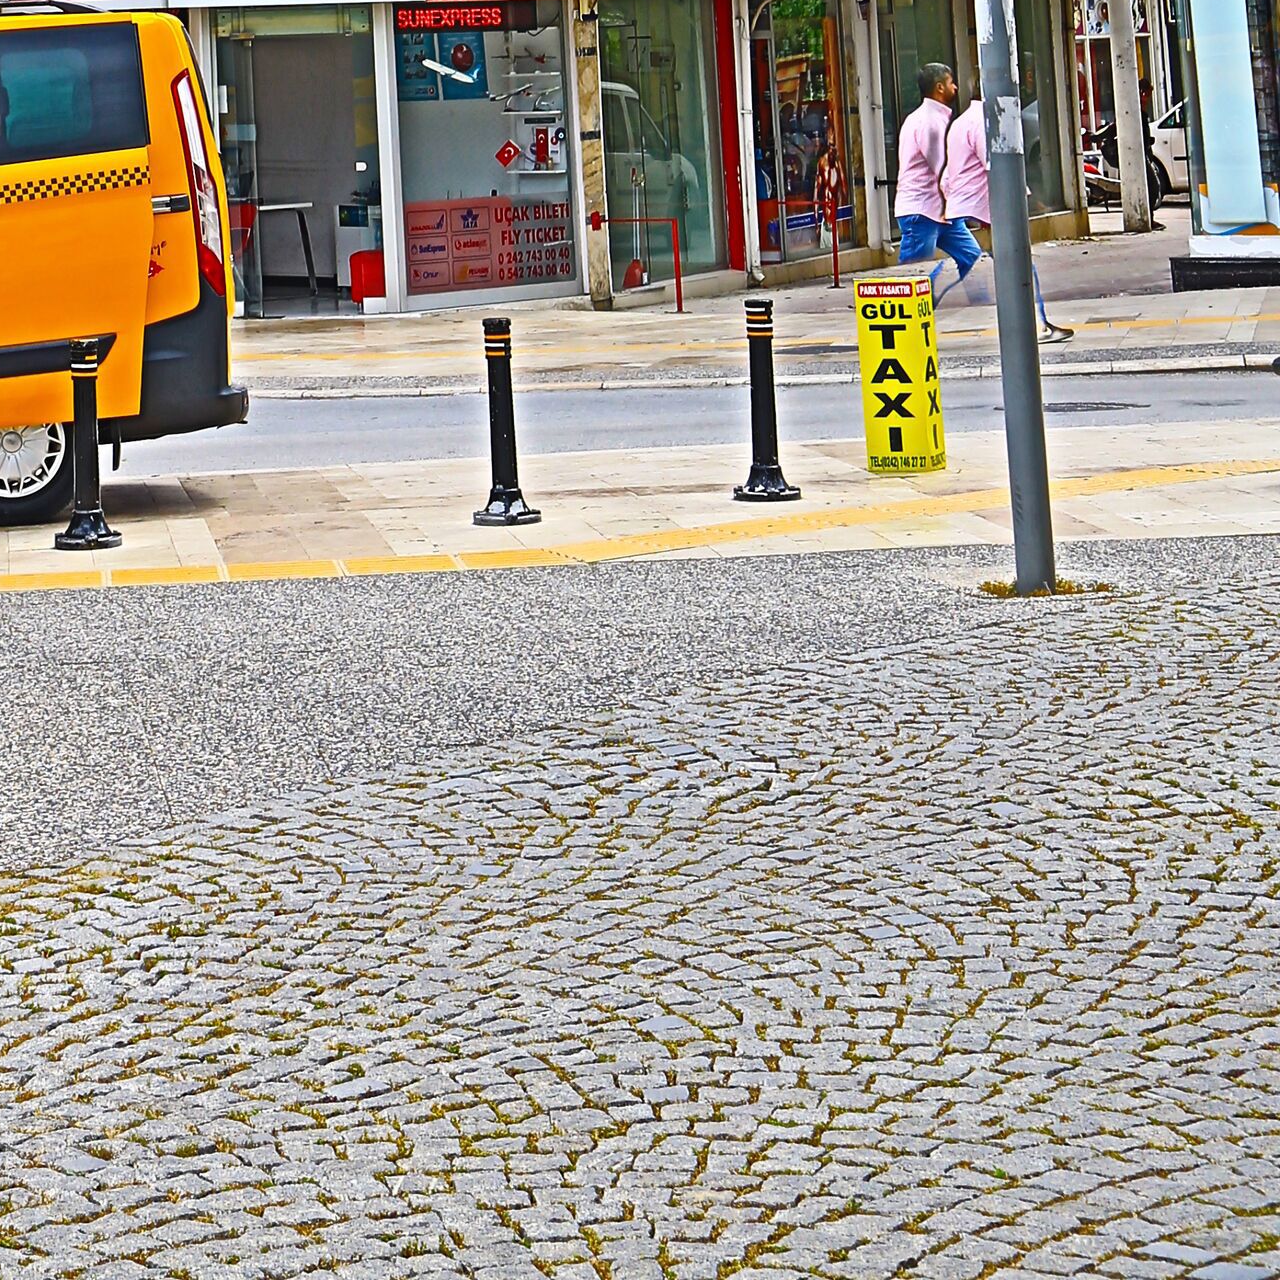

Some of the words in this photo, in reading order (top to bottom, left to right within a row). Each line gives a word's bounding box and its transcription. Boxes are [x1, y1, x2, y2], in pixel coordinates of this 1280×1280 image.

[398, 7, 502, 28] SUNEXPRESS
[494, 207, 530, 226] UÇAK
[501, 229, 521, 246] FLY
[525, 226, 566, 244] TICKET
[498, 253, 504, 265] 0
[506, 251, 524, 264] 242
[526, 250, 542, 262] 743
[545, 248, 556, 260] 00
[558, 247, 570, 259] 40
[499, 268, 504, 280] 0
[507, 267, 524, 279] 542
[527, 265, 543, 278] 743
[546, 263, 557, 275] 00
[559, 262, 570, 275] 40
[861, 300, 913, 320] GÜL
[868, 324, 916, 452] TAXI
[920, 321, 940, 450] TAXI
